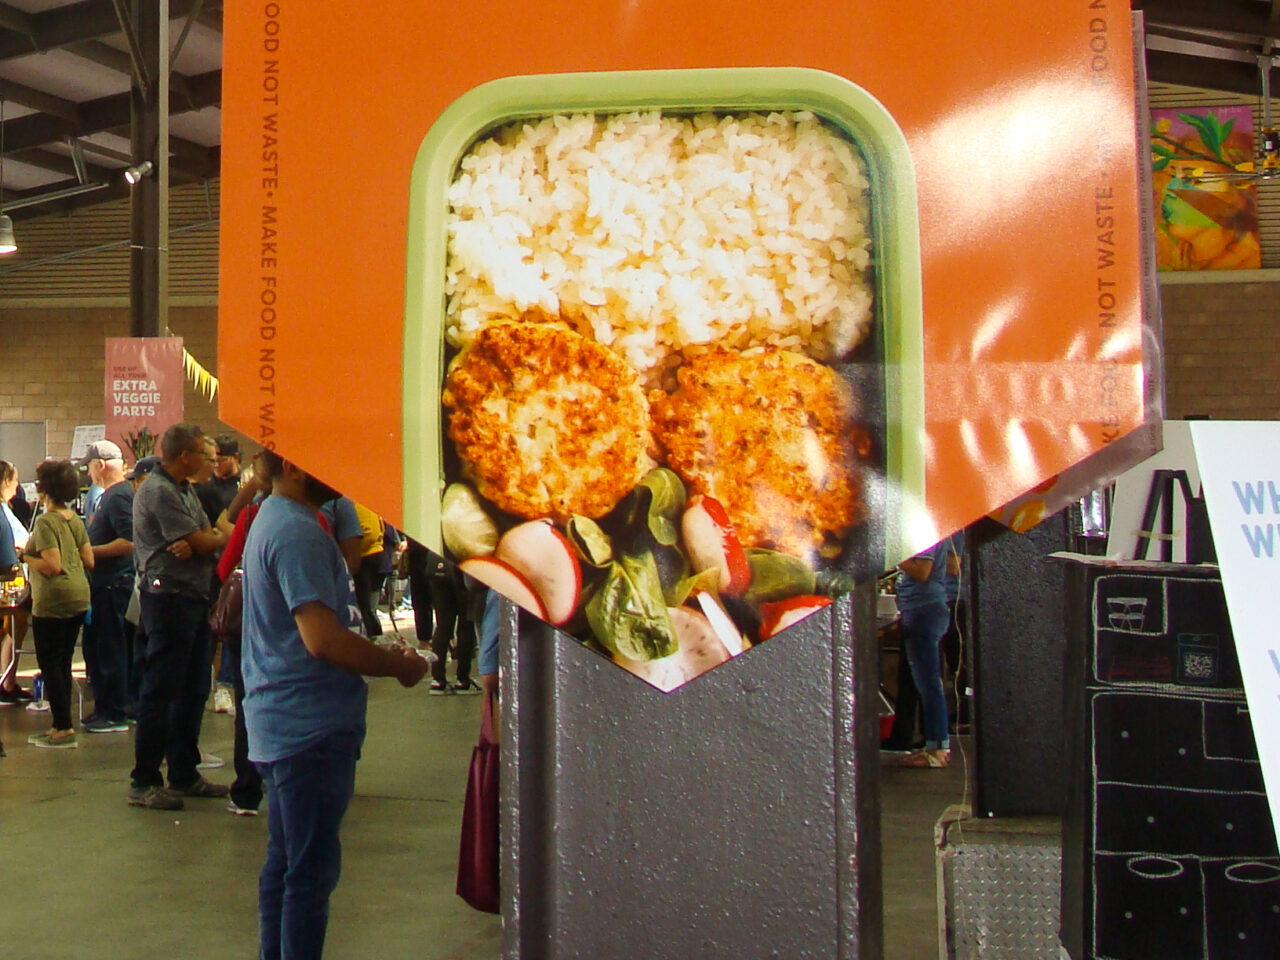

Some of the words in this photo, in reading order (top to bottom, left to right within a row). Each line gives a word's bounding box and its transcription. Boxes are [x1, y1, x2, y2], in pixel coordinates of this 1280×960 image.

[263, 60, 279, 105] NOT
[262, 112, 278, 188] WASTE
[261, 206, 277, 268] MAKE
[1096, 187, 1116, 269] WASTE
[260, 277, 277, 340] FOOD
[1097, 279, 1116, 328] NOT
[113, 380, 158, 391] EXTRA
[259, 349, 275, 394] NOT
[113, 393, 161, 403] VEGGIE
[113, 406, 155, 417] PARTS
[1241, 524, 1280, 558] W
